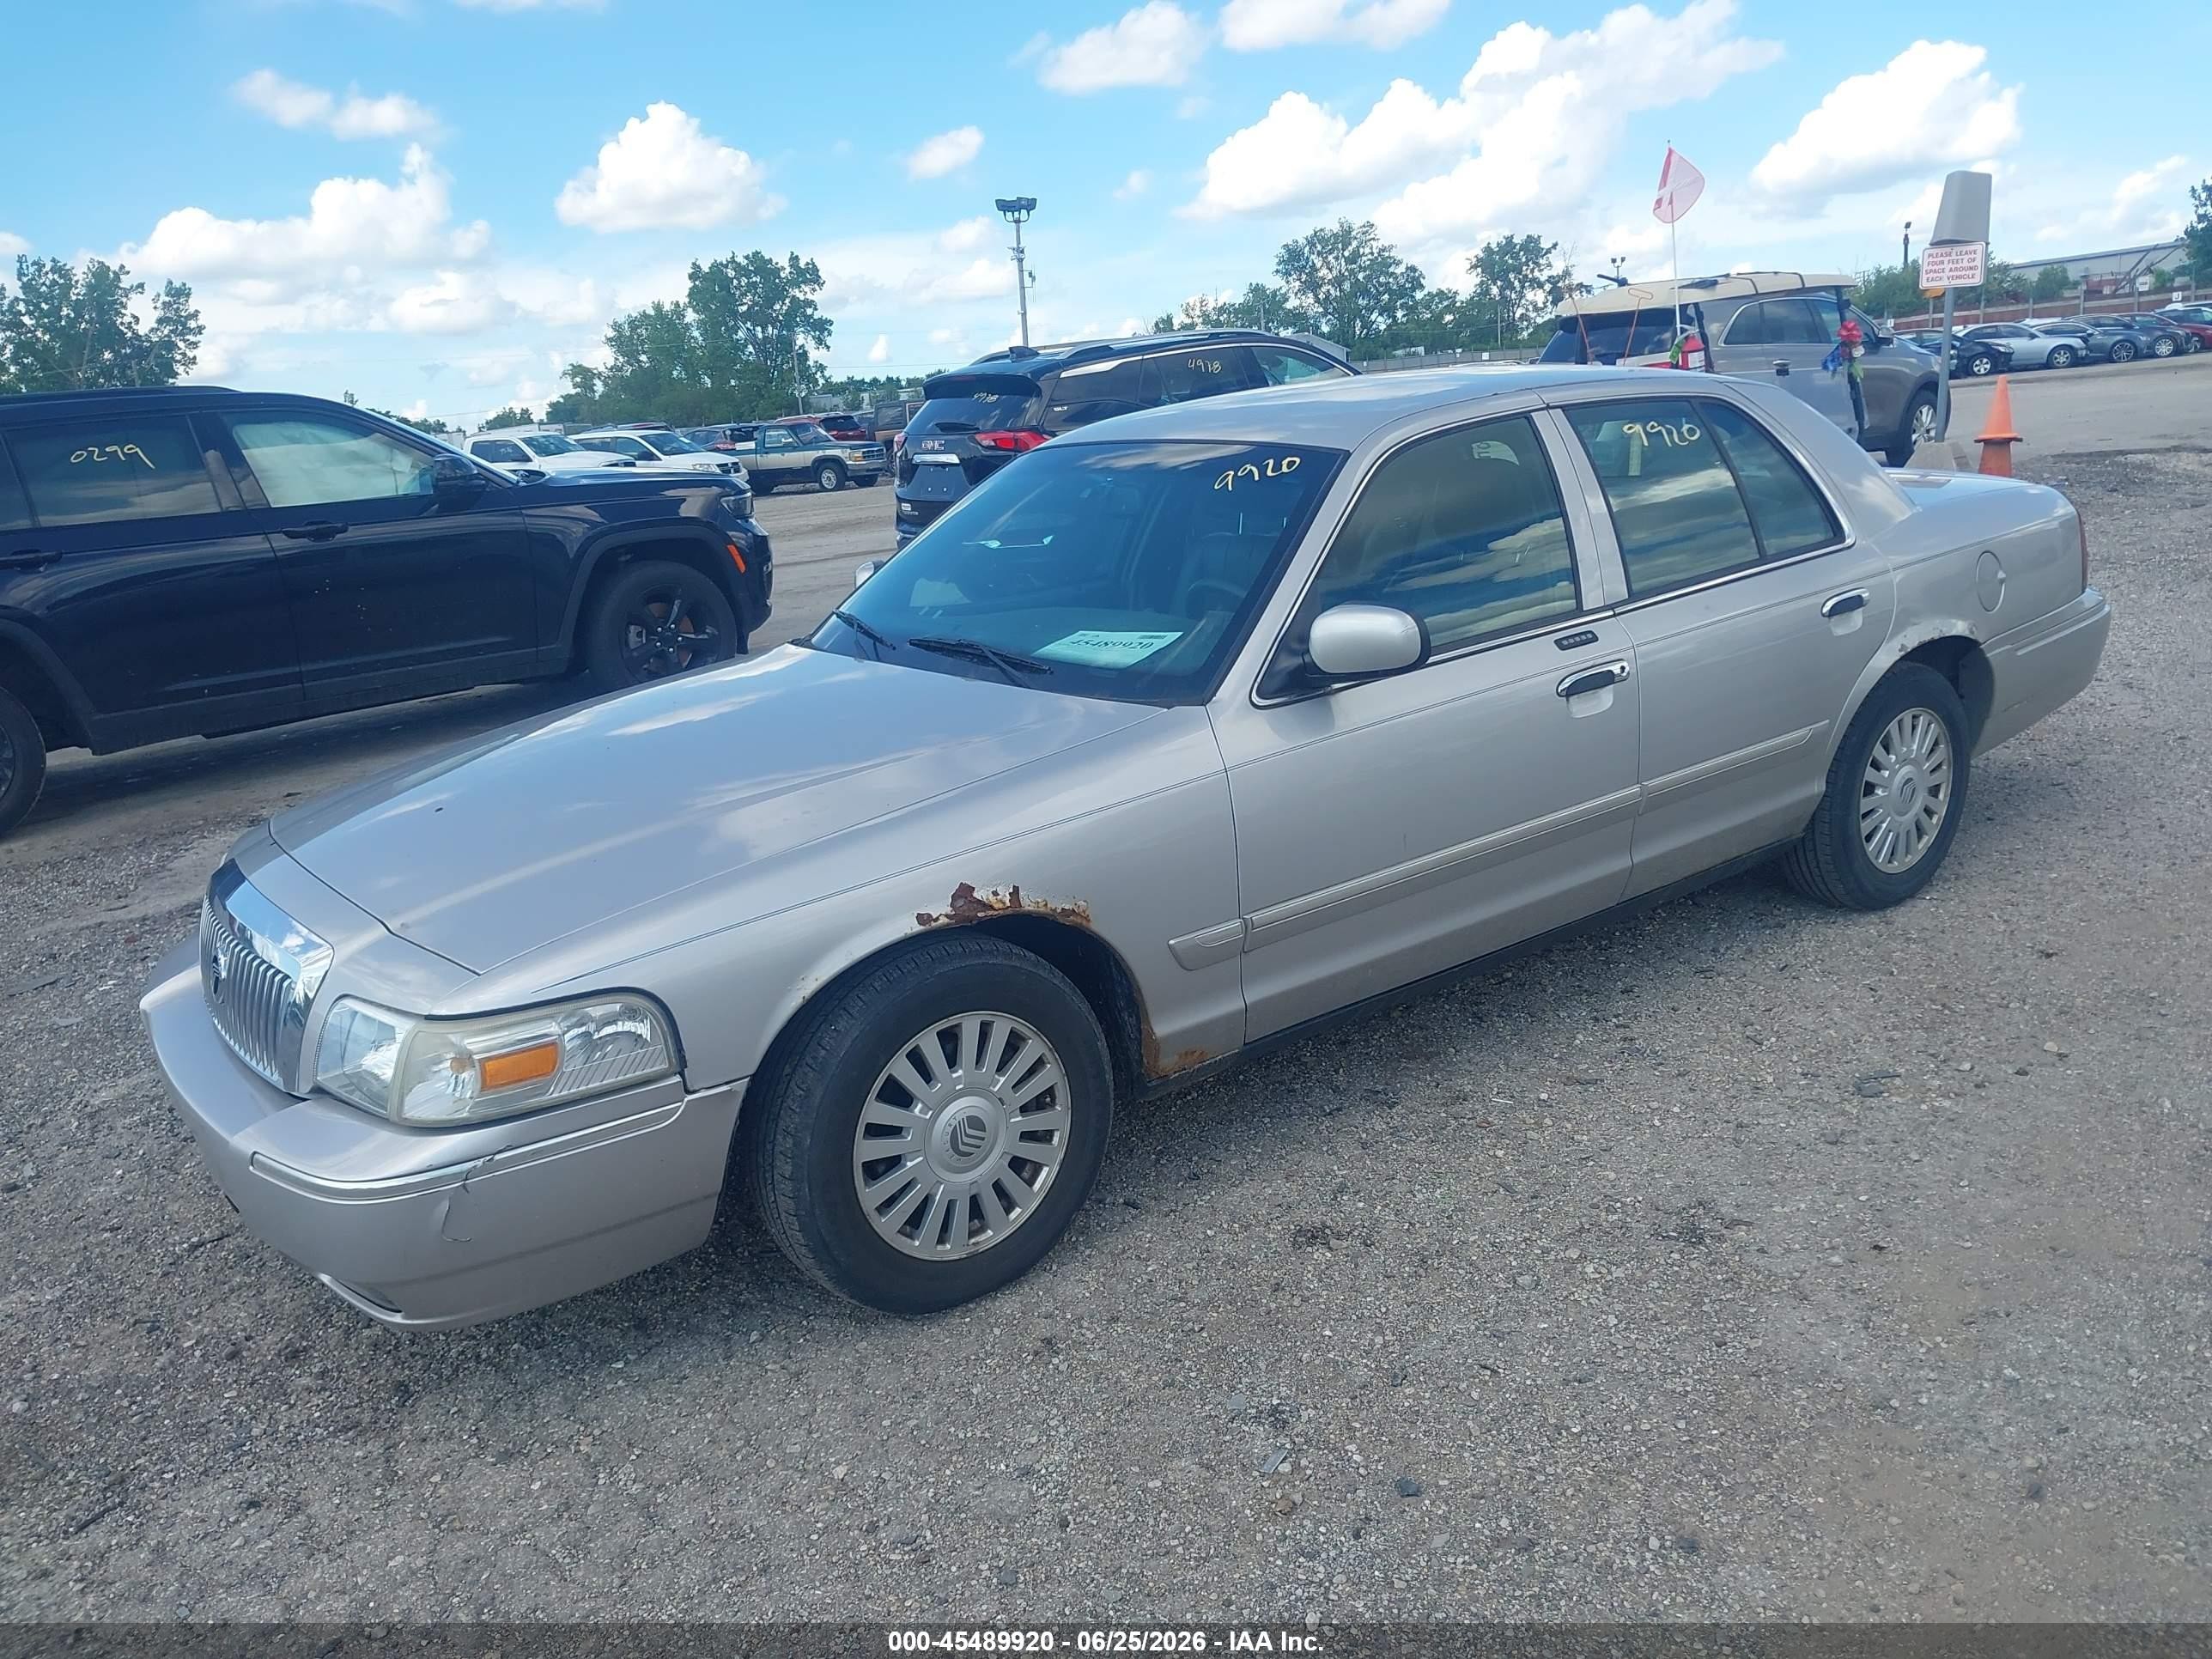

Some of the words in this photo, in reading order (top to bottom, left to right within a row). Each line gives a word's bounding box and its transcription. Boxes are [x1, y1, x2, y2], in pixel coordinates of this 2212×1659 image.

[1928, 251, 1953, 259] PLEASE
[921, 440, 945, 451] GMC
[1622, 419, 1700, 447] 9920
[70, 443, 155, 469] 0299
[1213, 456, 1301, 491] 9920
